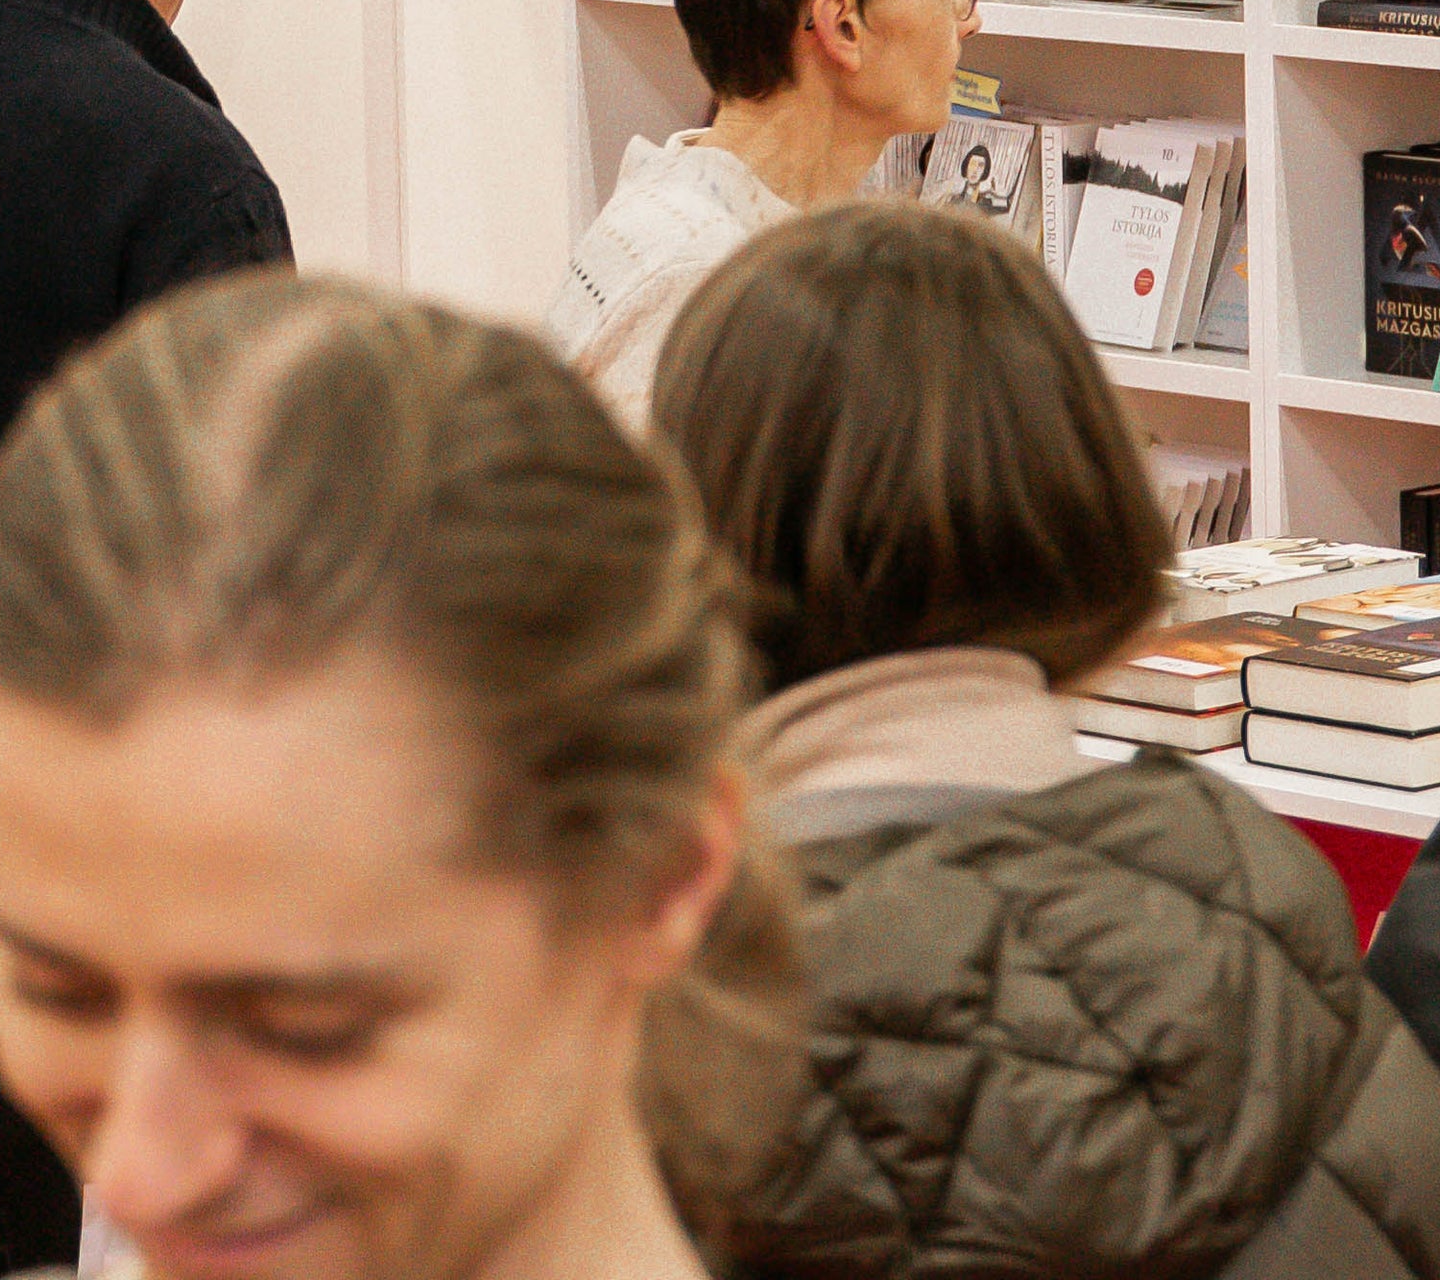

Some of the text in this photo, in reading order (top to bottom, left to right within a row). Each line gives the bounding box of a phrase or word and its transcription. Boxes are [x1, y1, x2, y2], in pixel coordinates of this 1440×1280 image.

[1044, 132, 1056, 195] TYLOS
[1131, 204, 1170, 224] TYLOS
[1112, 219, 1163, 241] ISTORIJA
[1376, 316, 1440, 340] MAZGAS
